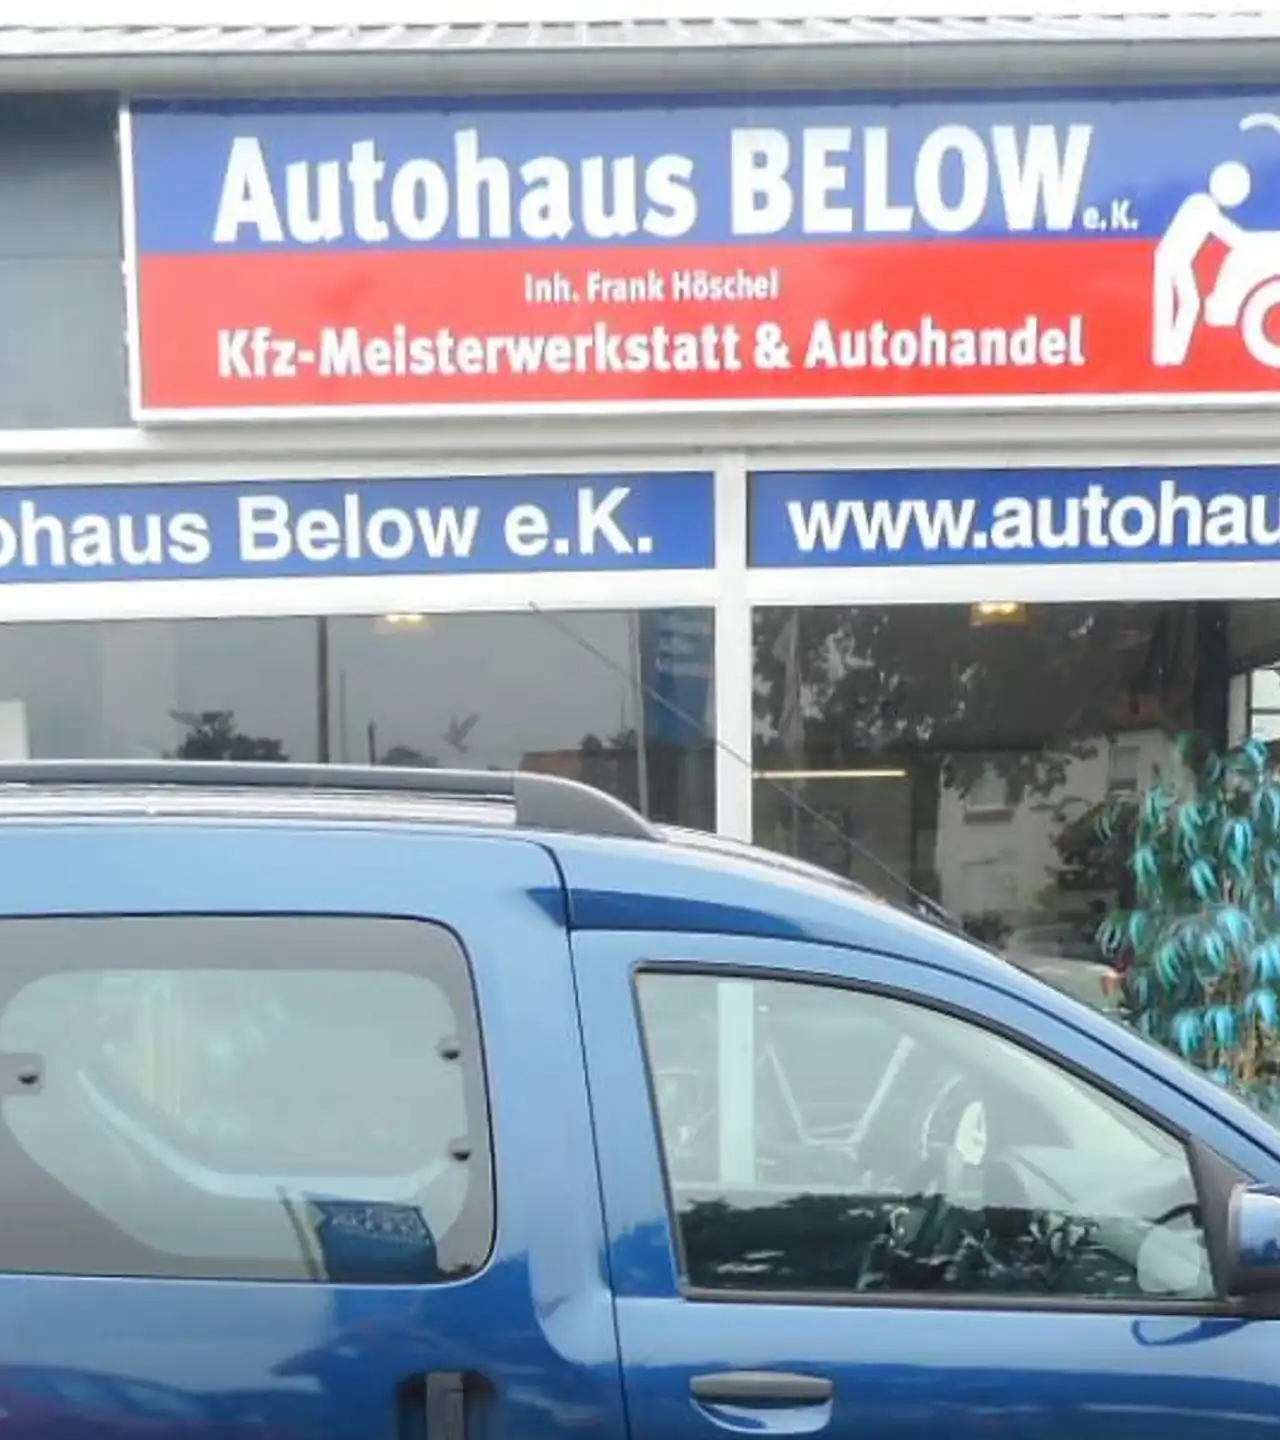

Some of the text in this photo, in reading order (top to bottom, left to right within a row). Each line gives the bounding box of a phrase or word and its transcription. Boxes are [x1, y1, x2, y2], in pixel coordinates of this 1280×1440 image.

[212, 123, 1140, 244] Autohaus BELOW e.K.
[523, 266, 779, 304] Inh. Frank Höschel
[217, 314, 1086, 379] Kfz-Meisterwerkstatt & Autohandel
[238, 493, 480, 563] Below
[503, 486, 653, 556] e.K.
